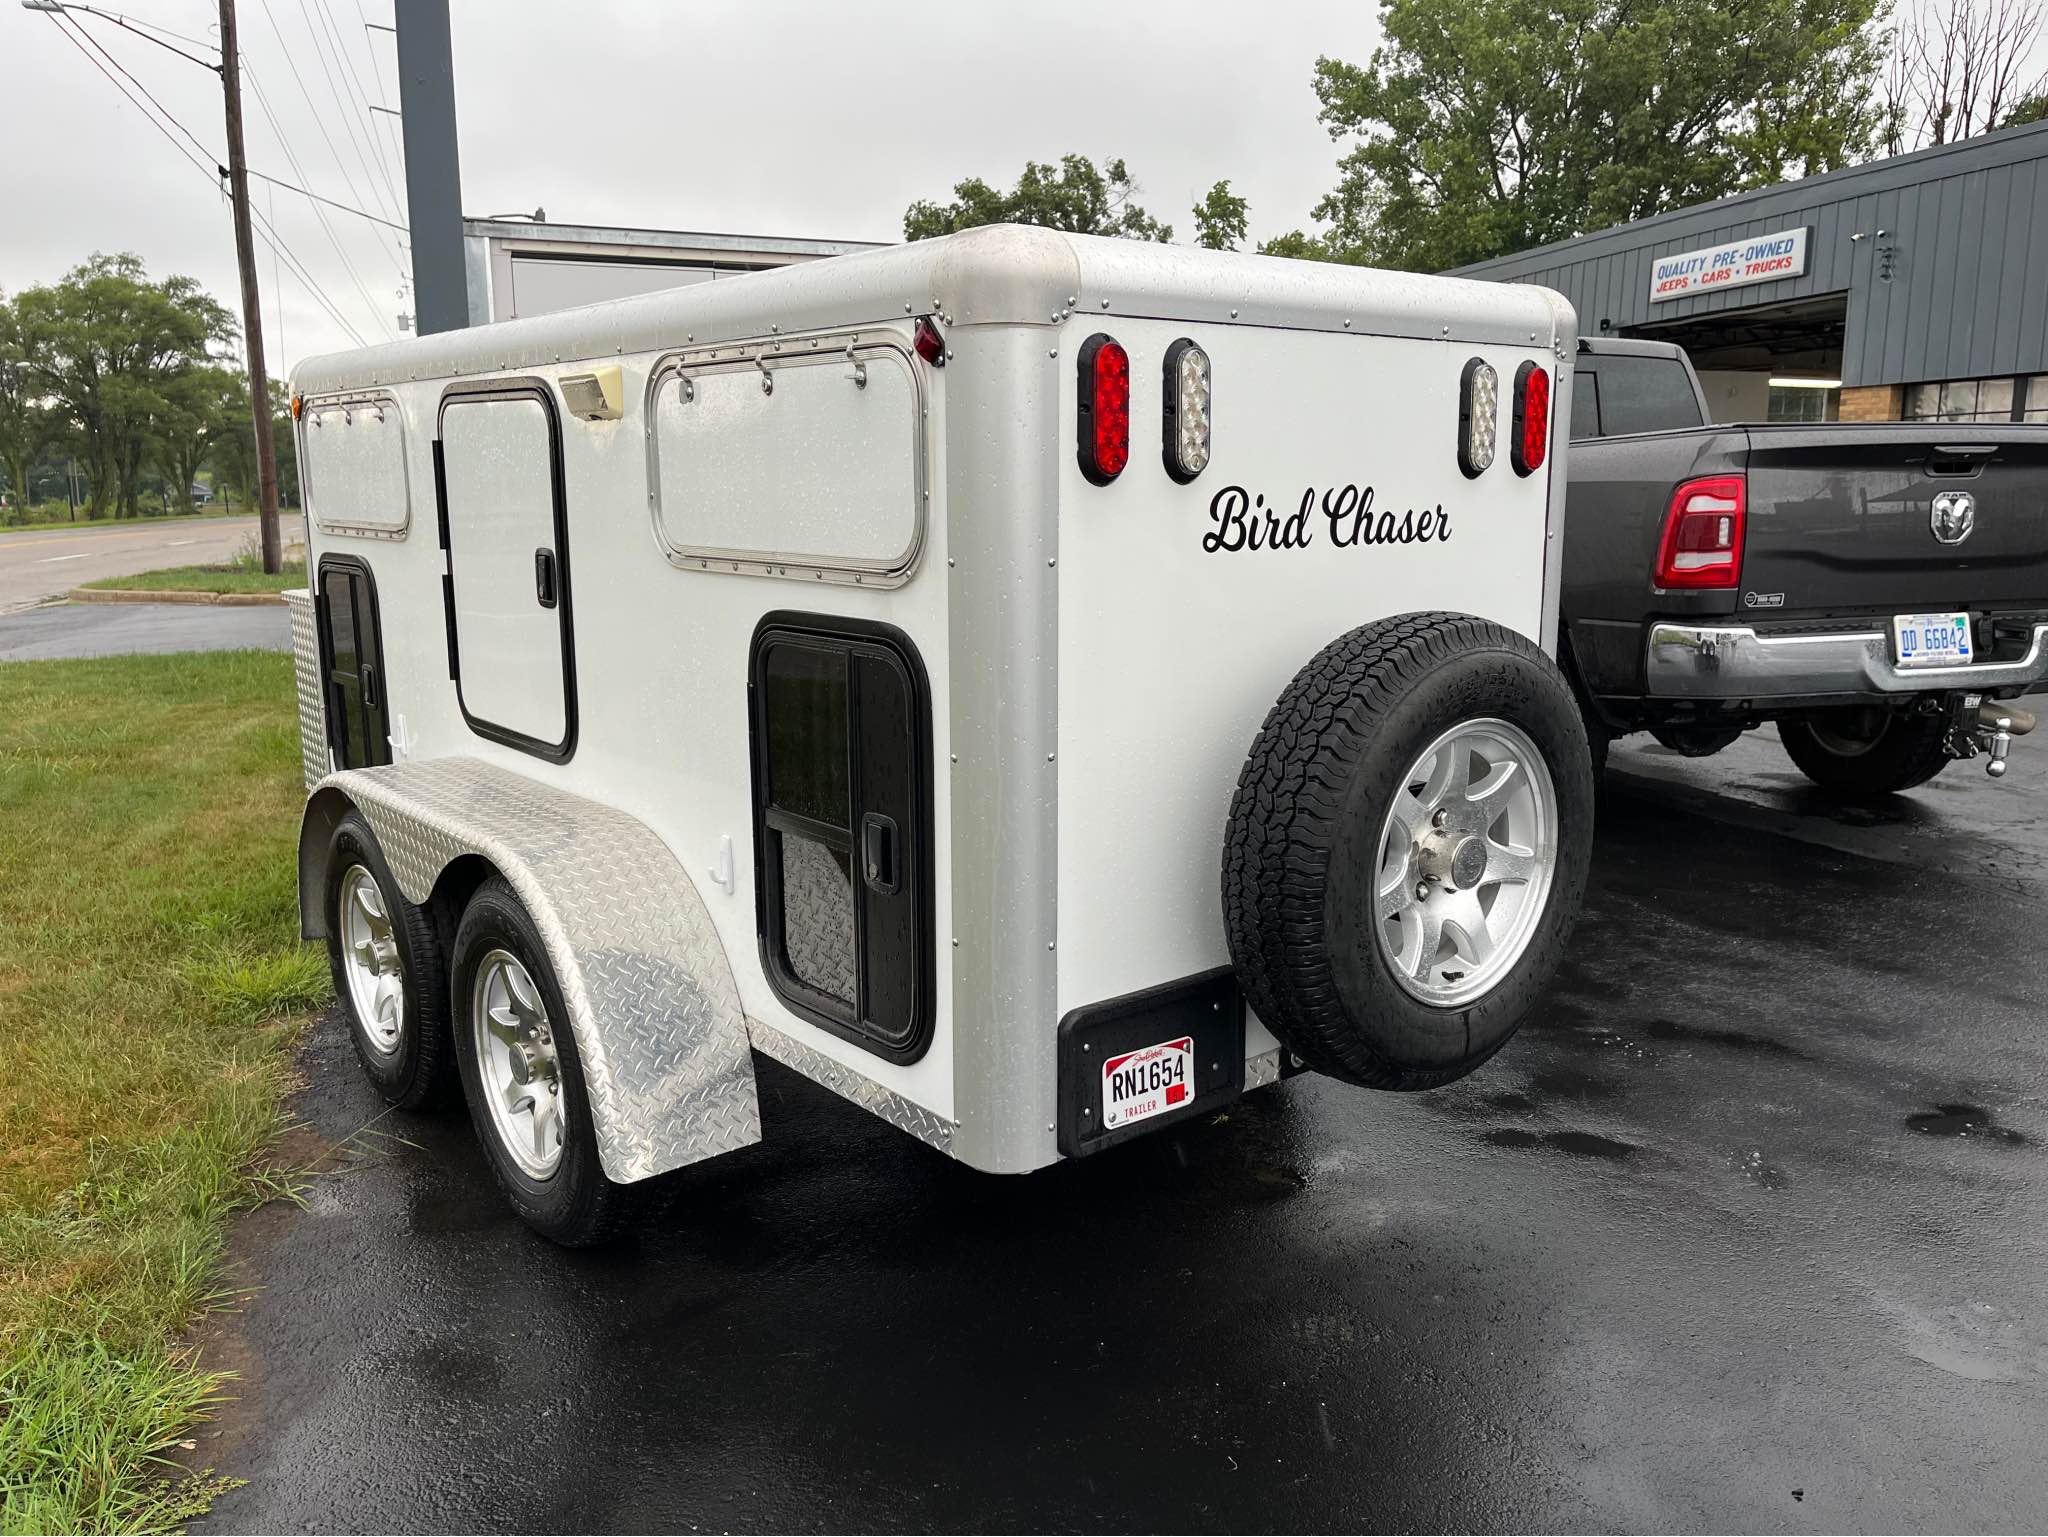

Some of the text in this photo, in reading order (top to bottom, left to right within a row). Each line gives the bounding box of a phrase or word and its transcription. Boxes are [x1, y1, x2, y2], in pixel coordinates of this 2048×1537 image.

[1656, 256, 1793, 293] JEEPS CARS TRUCKS
[1657, 238, 1794, 280] QUALITY PRE-OWNED
[1202, 483, 1453, 553] Bird Chaser
[1112, 1053, 1184, 1103] RN1654
[1124, 1099, 1157, 1118] TRAILER
